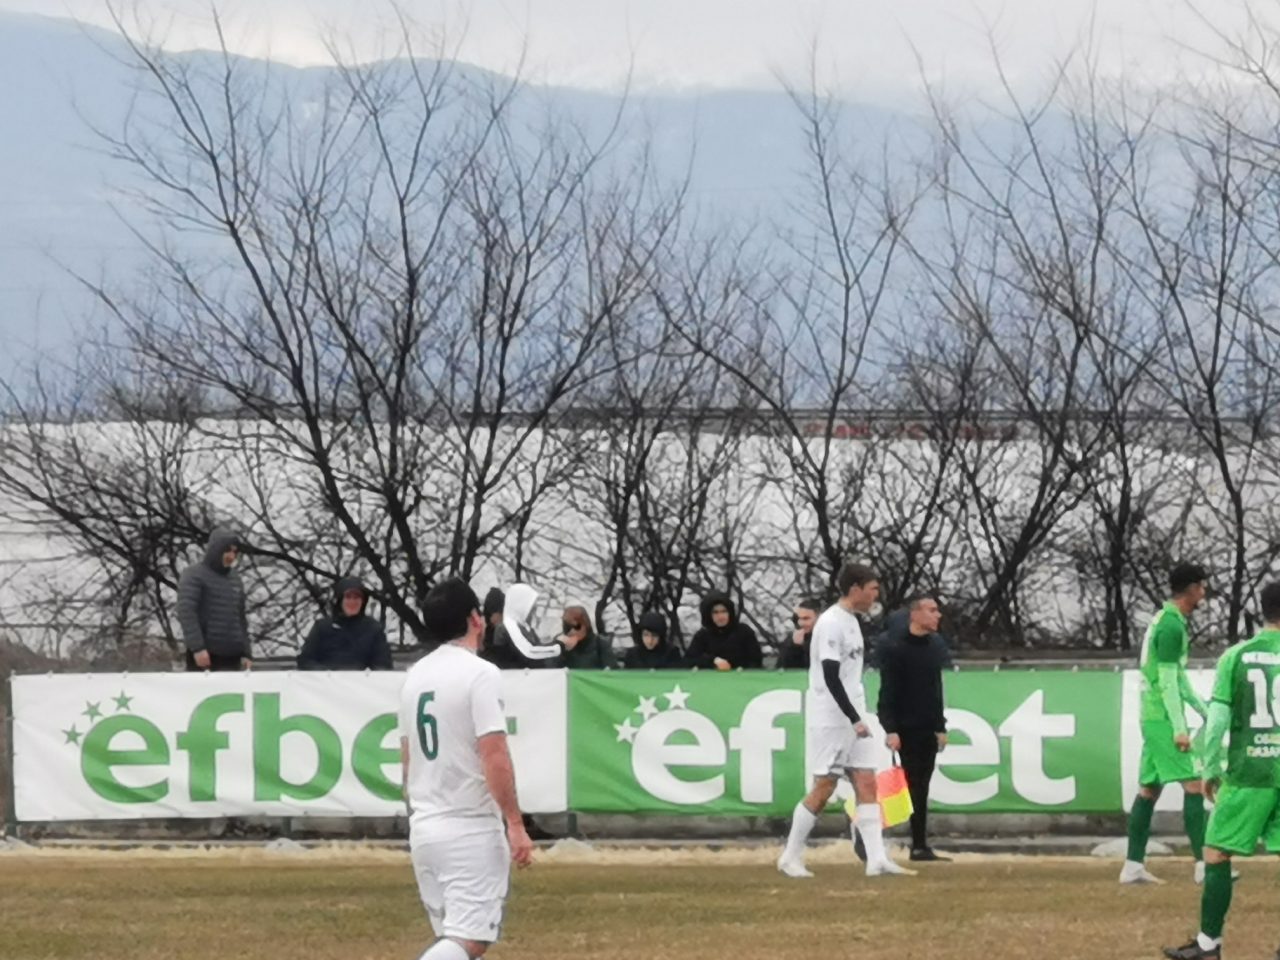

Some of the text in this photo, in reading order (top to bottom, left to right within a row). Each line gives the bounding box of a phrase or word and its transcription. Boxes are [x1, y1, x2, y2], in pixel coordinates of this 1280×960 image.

[80, 692, 517, 804] efbe
[416, 691, 438, 761] 6
[631, 689, 1077, 805] efet
